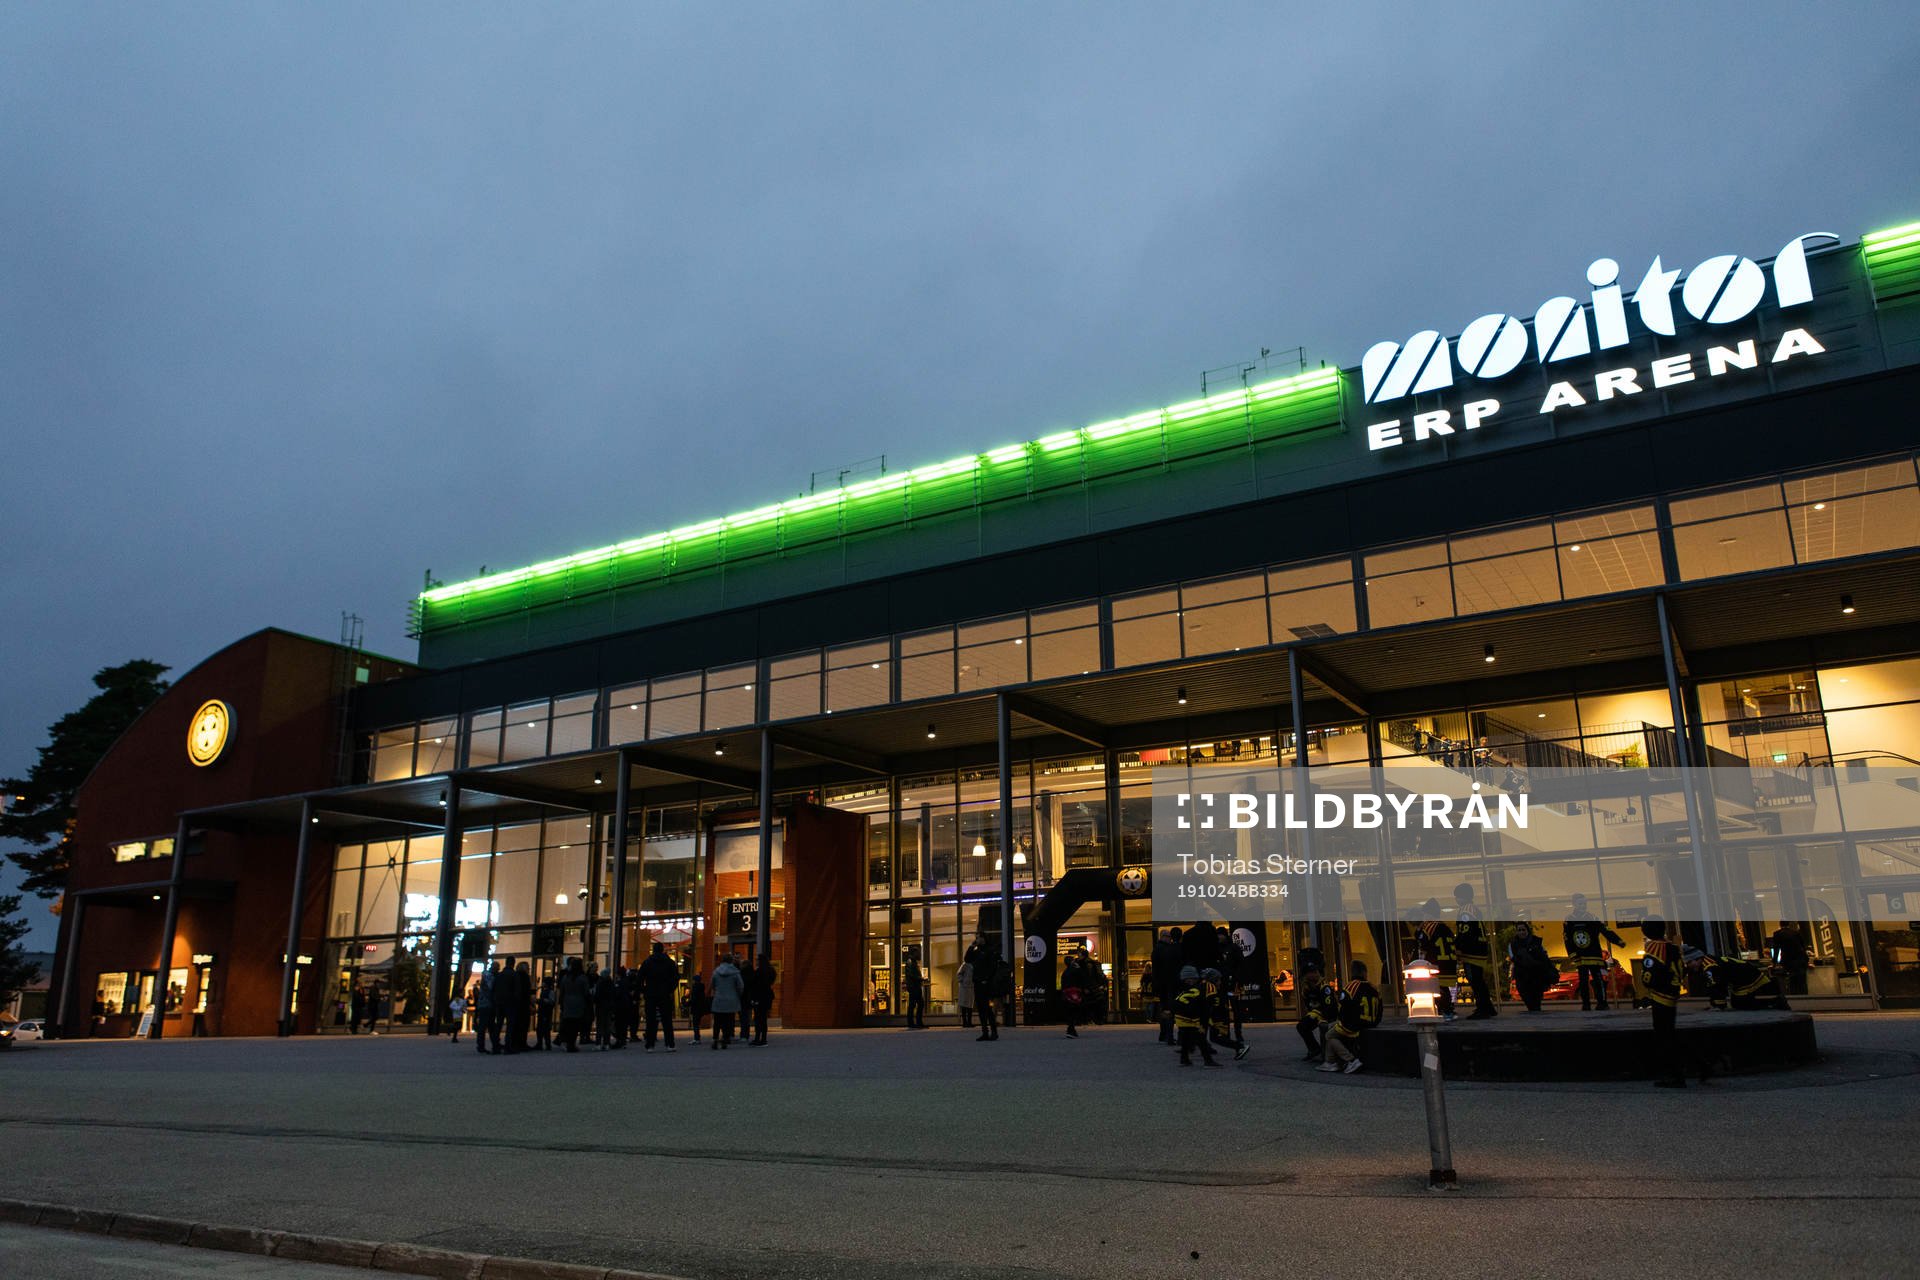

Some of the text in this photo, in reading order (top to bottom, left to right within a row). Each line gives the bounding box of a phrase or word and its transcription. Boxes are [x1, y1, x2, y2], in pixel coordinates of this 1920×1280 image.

[1361, 231, 1840, 404] monitor
[1367, 327, 1826, 450] ERP ARENA
[732, 902, 758, 914] ENTR
[1890, 897, 1902, 910] 6
[741, 914, 752, 932] 3
[546, 938, 556, 952] 2
